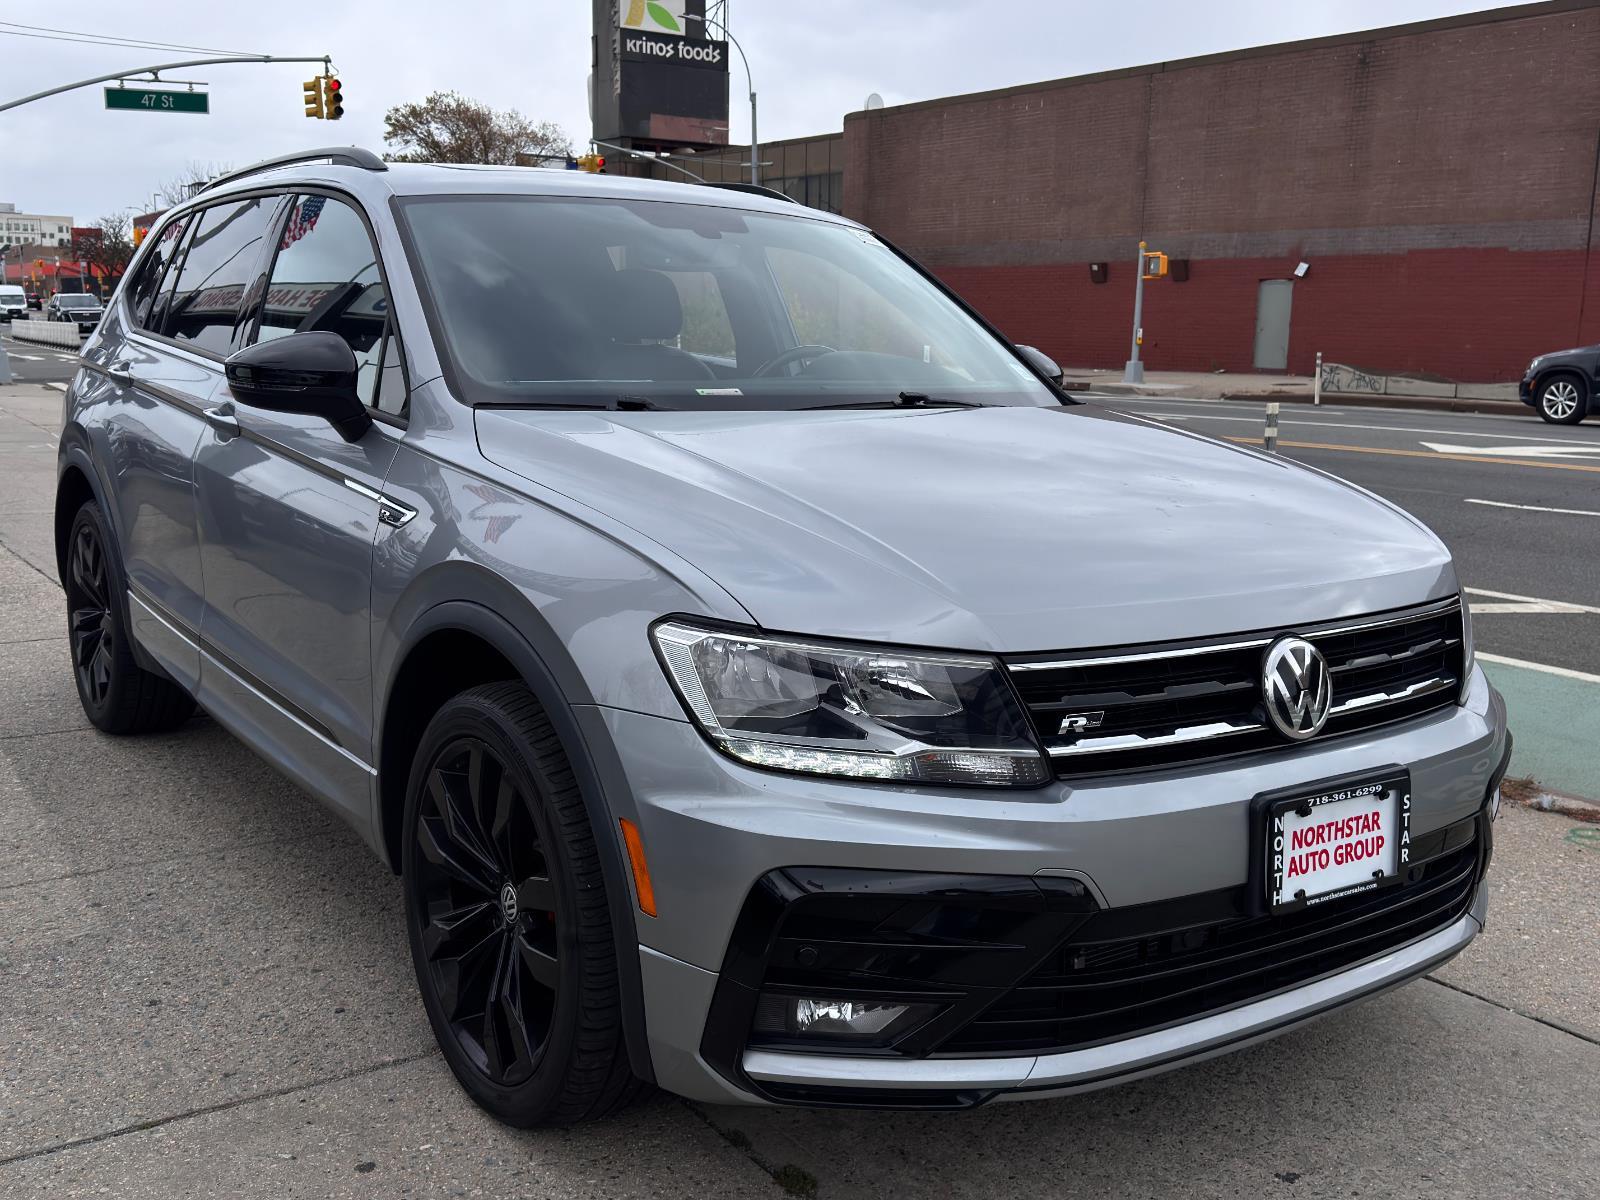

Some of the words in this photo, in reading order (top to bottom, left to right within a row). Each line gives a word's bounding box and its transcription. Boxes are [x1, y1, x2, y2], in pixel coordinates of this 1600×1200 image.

[678, 42, 721, 63] foods
[141, 95, 156, 107] 47
[161, 95, 174, 108] St
[1263, 632, 1332, 741] VW
[1307, 785, 1383, 807] 718-361-6299
[1291, 811, 1381, 850] NORTHSTAR
[1401, 794, 1410, 863] STAR
[1273, 817, 1284, 906] NORTH
[1287, 848, 1330, 878] AUTO
[1333, 835, 1385, 865] GROUP
